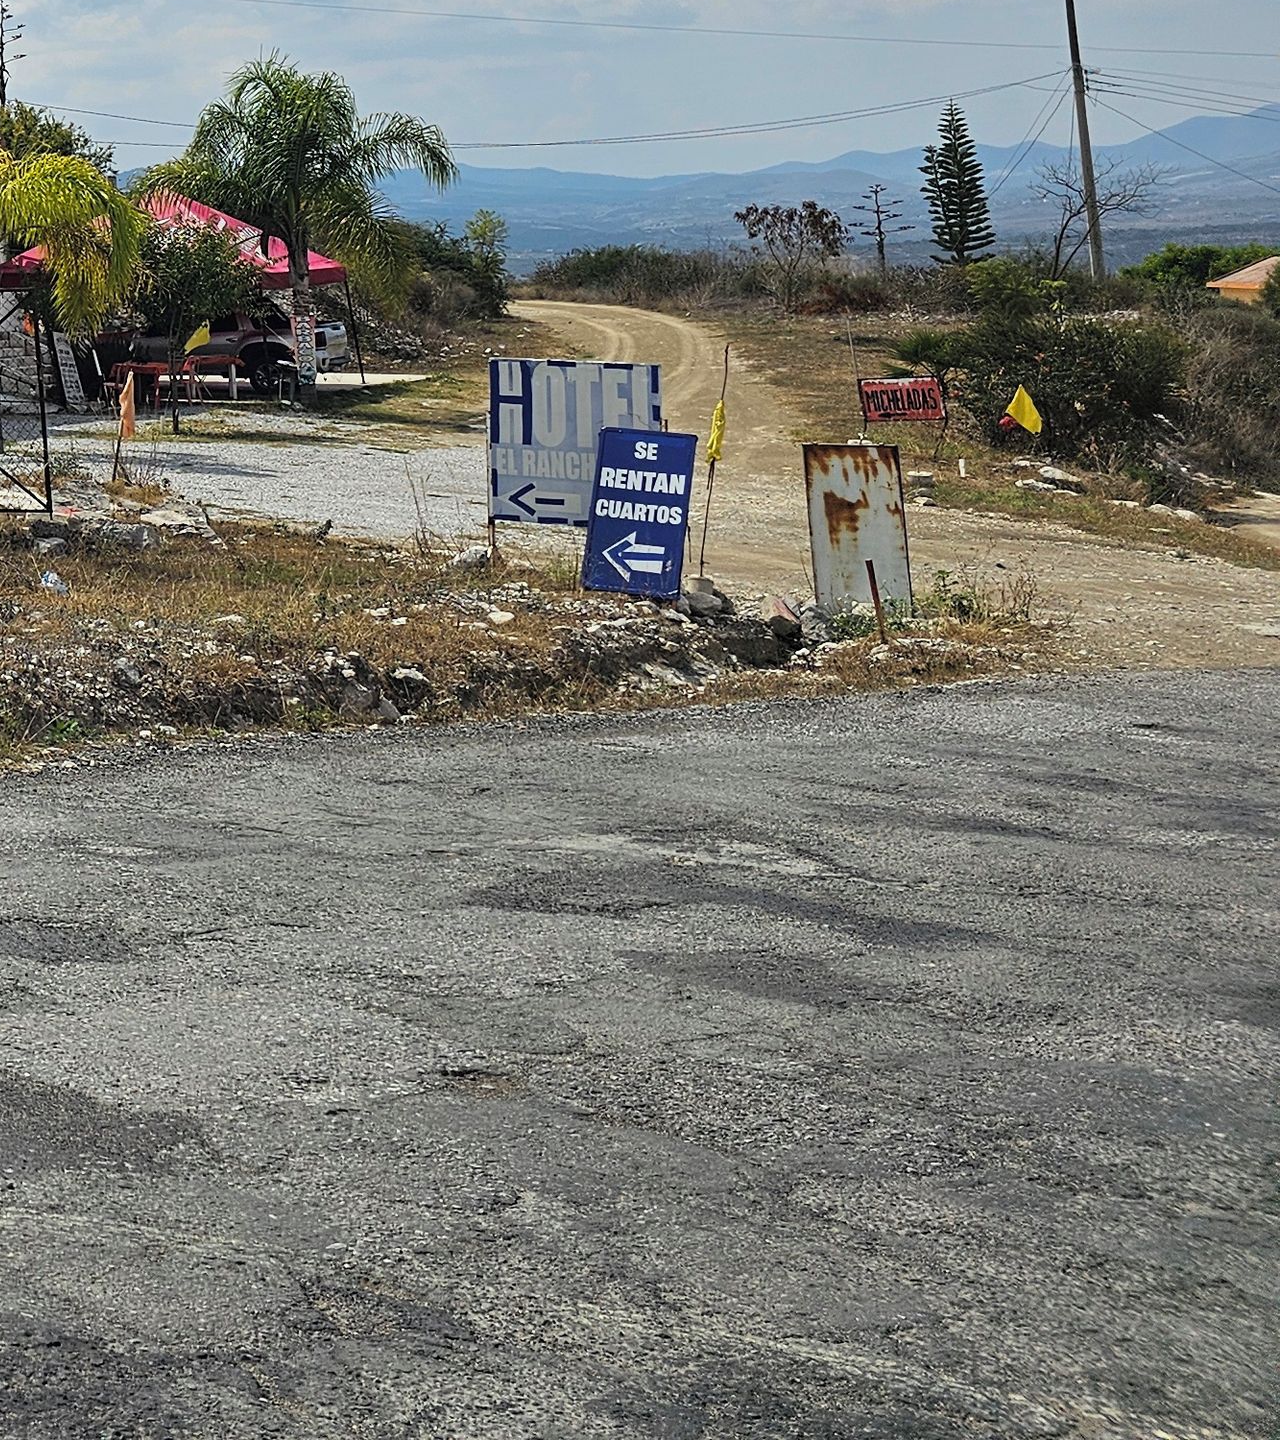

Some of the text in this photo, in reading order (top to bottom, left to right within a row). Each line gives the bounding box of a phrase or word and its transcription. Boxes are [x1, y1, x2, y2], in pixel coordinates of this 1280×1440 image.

[864, 388, 938, 413] MICHELADAS
[496, 448, 518, 475] EL
[634, 441, 659, 461] SE
[600, 467, 686, 495] RENTAN
[595, 498, 683, 525] CUARTOS
